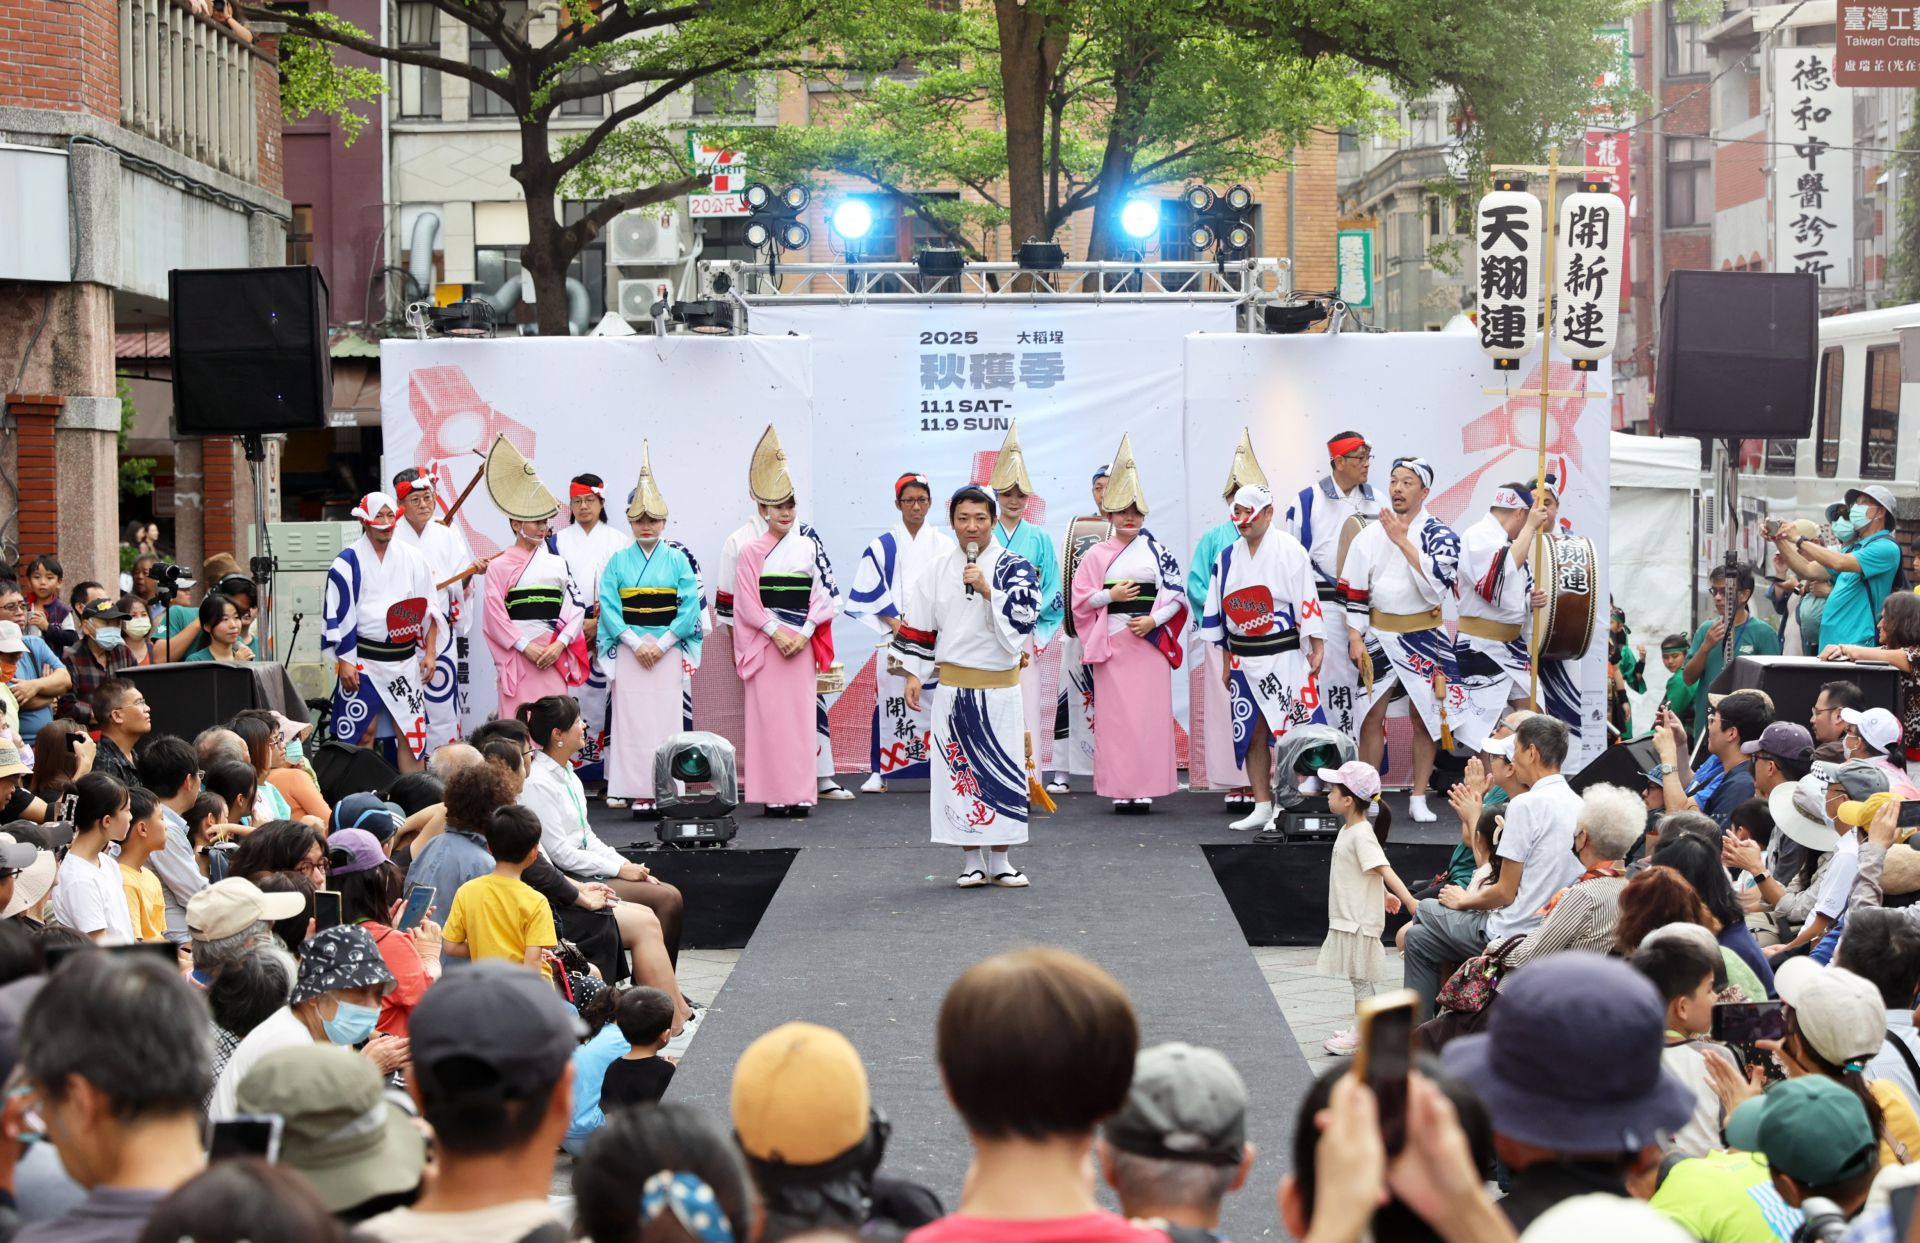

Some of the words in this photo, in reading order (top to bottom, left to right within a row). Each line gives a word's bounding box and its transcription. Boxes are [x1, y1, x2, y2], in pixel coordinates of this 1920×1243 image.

[1845, 35, 1885, 46] Taiwan
[691, 197, 737, 214] 20公尺
[1481, 205, 1529, 349] 天翔連
[1564, 205, 1609, 348] 開新連
[920, 331, 978, 345] 2025
[1017, 331, 1064, 344] 大稻埕
[920, 352, 1065, 391] 秋穫季
[921, 400, 955, 413] 11.1
[958, 400, 1012, 413] SAT-
[921, 418, 959, 431] 11.9
[963, 418, 1009, 430] SUN
[1259, 672, 1311, 727] 開新連
[886, 696, 928, 762] 開新連
[945, 741, 996, 827] 天翔連
